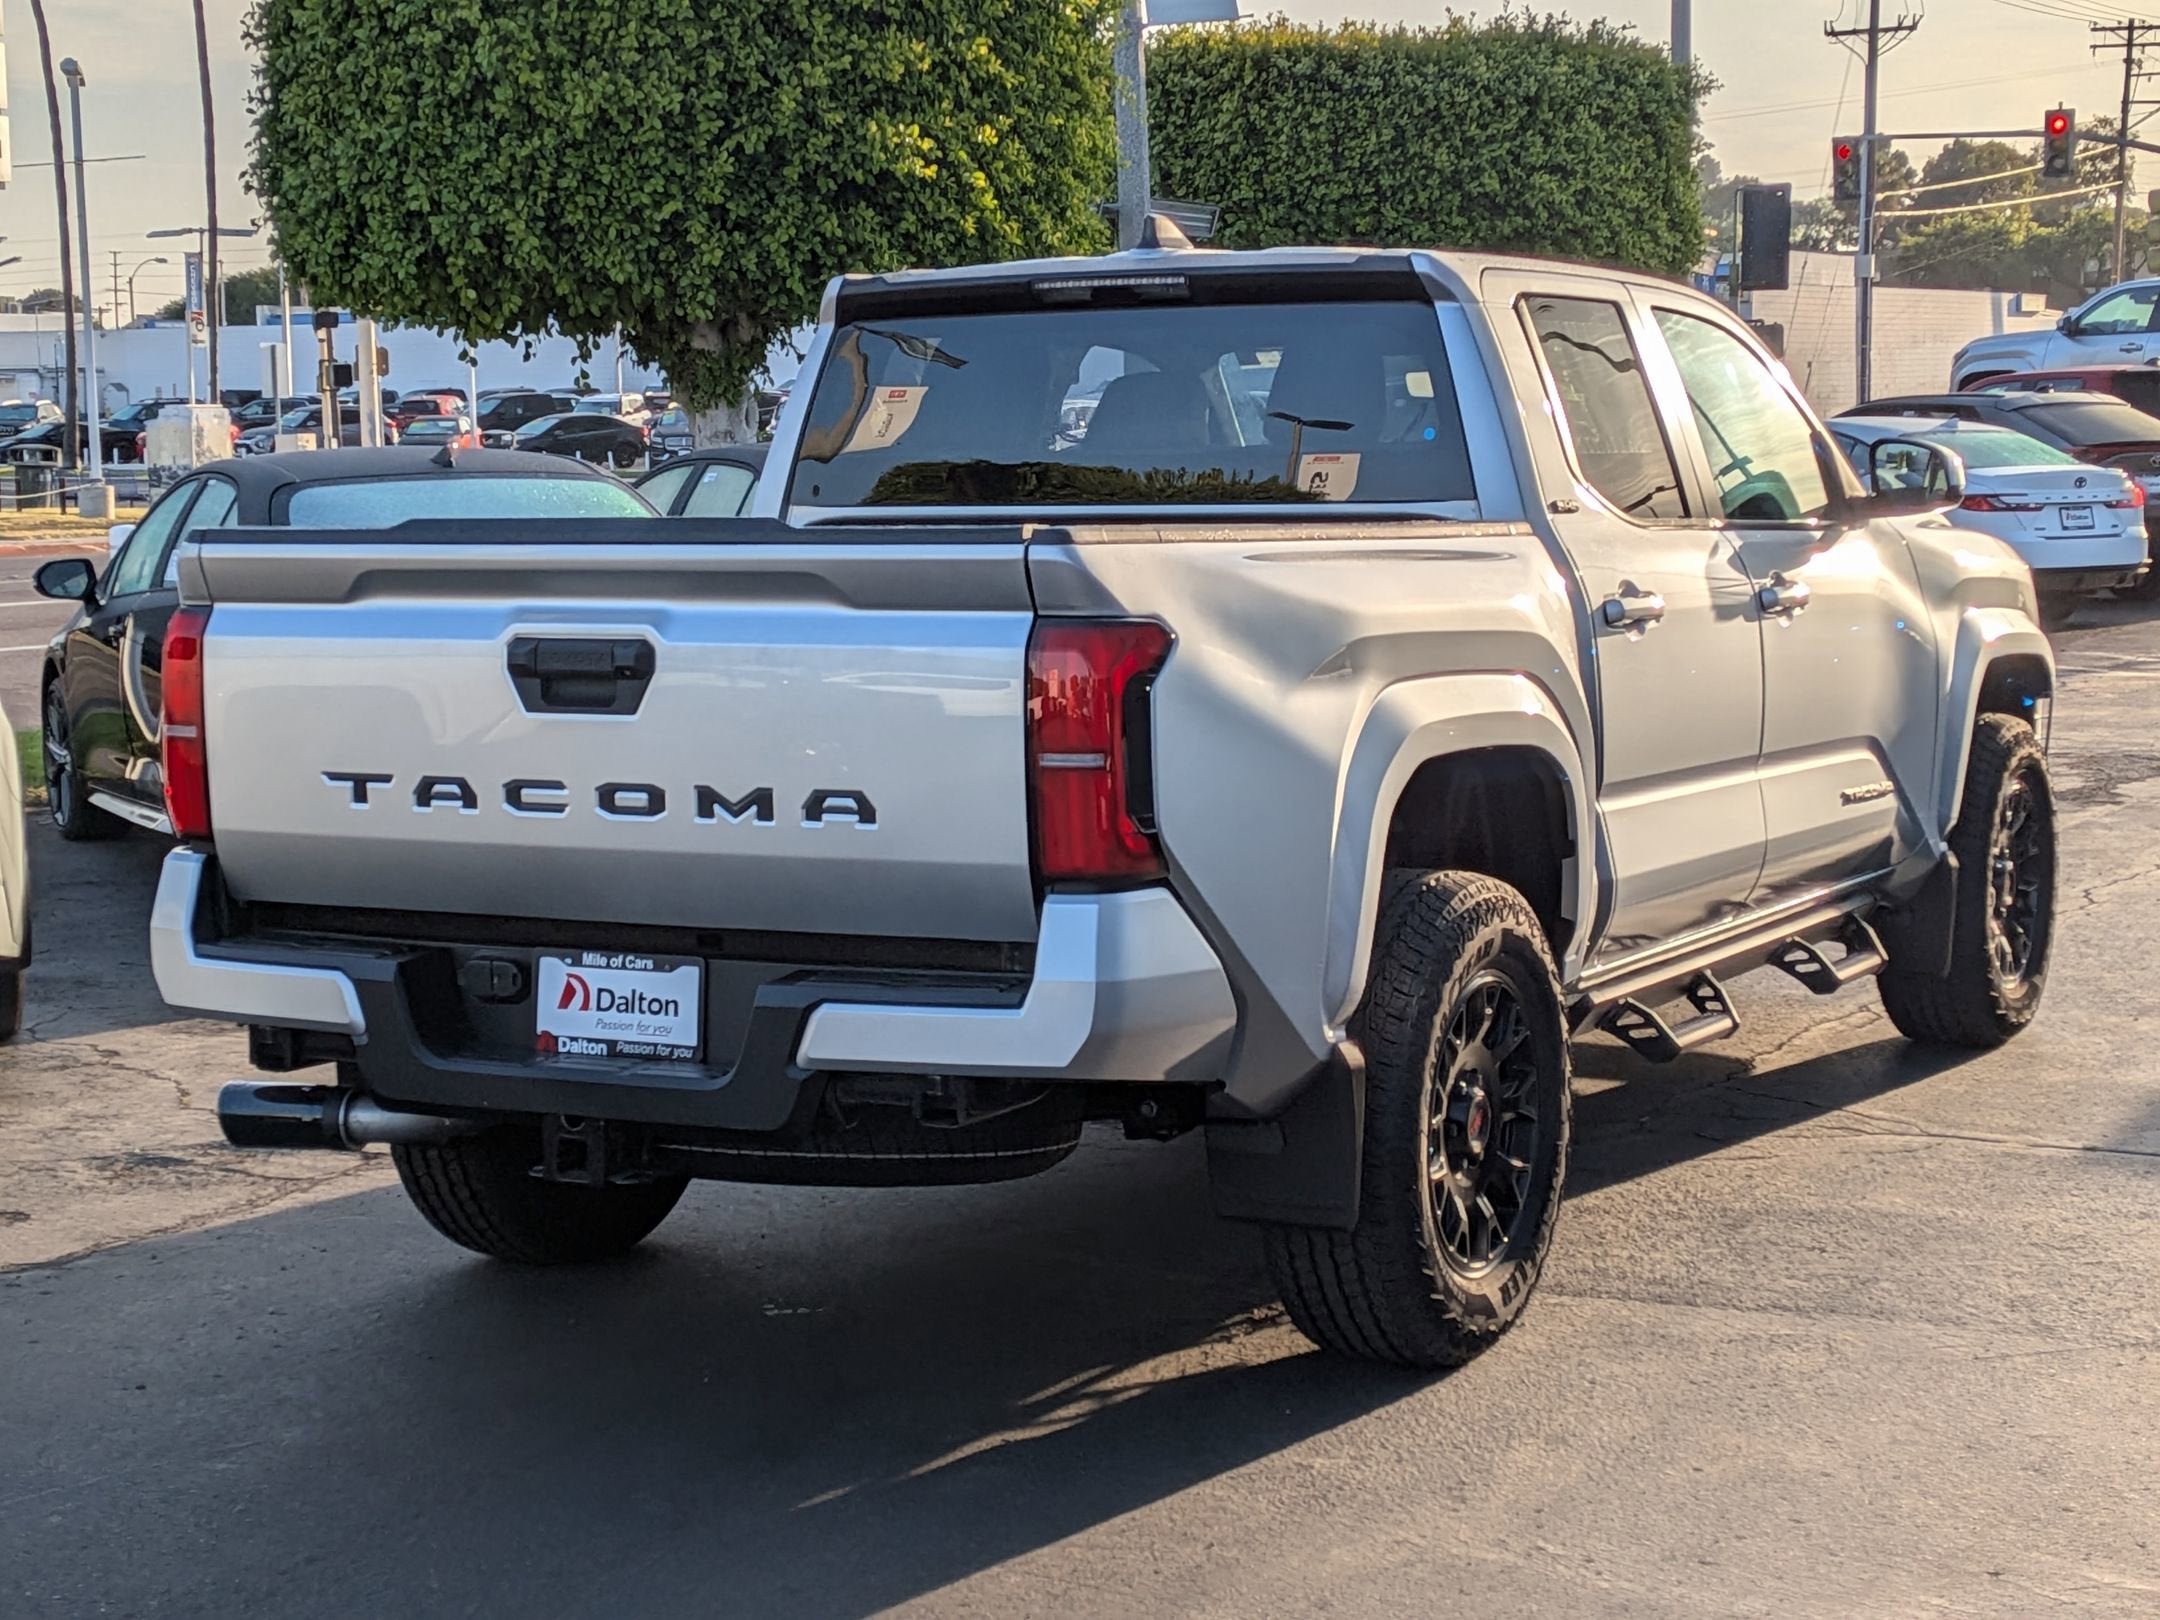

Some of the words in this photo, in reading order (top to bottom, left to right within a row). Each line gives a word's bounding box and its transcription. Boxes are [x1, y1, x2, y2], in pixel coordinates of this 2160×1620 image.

[320, 770, 879, 831] TACOMA
[582, 952, 607, 967] Mile
[609, 953, 624, 968] of
[625, 955, 654, 970] Cars
[595, 987, 679, 1018] Dalton
[595, 1018, 634, 1031] Passion
[636, 1022, 651, 1034] for
[652, 1025, 673, 1035] you
[558, 1037, 608, 1056] Dalton
[616, 1041, 655, 1055] Passion
[656, 1043, 672, 1057] for
[672, 1047, 694, 1060] you
